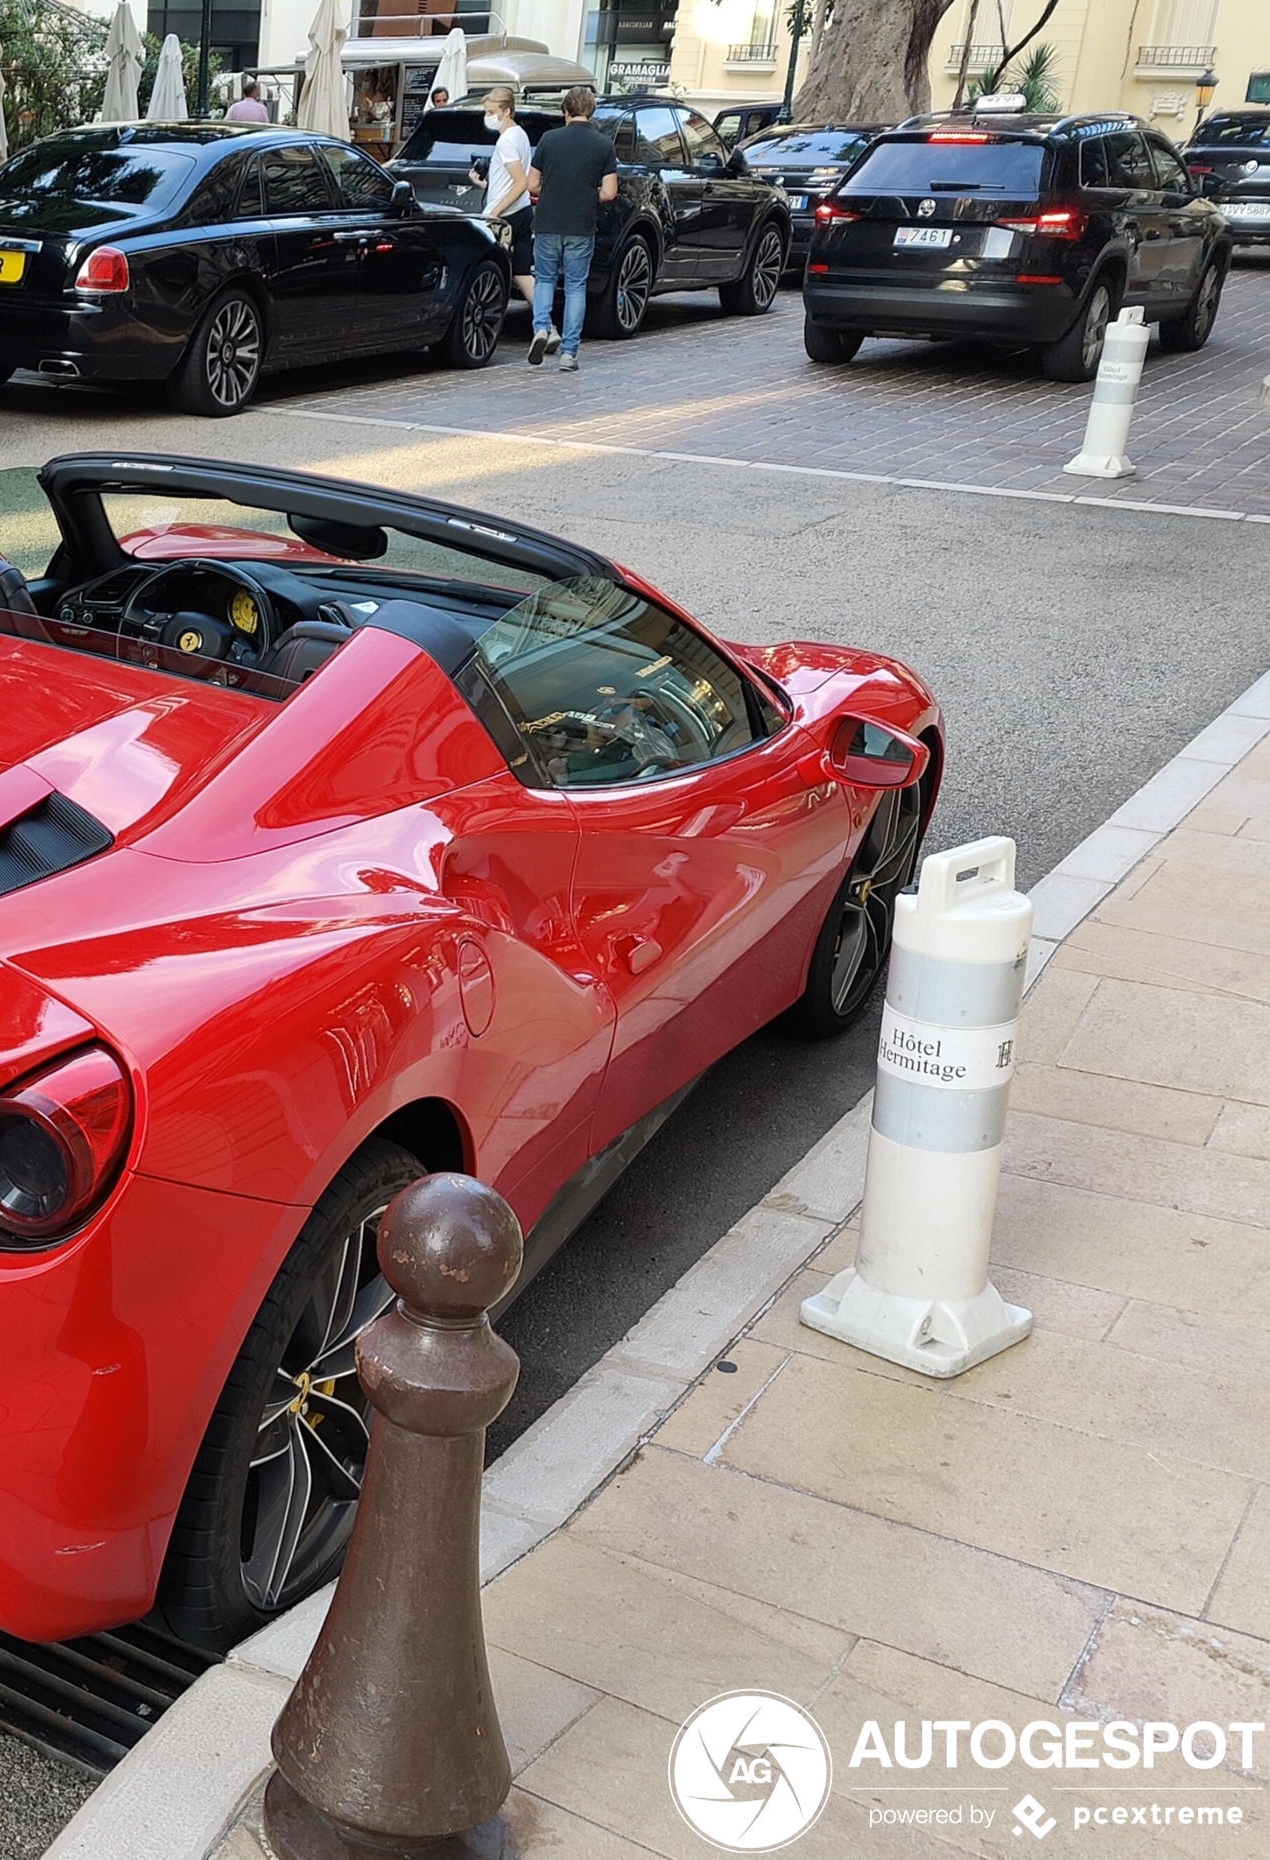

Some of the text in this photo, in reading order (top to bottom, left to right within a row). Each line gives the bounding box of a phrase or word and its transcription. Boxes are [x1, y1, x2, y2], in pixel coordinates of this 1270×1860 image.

[610, 63, 671, 76] GRAMAGLIA
[986, 97, 1016, 106] TAXI
[910, 229, 947, 243] 7461
[892, 1027, 943, 1058] Hôtel
[880, 1037, 968, 1082] Hermitage
